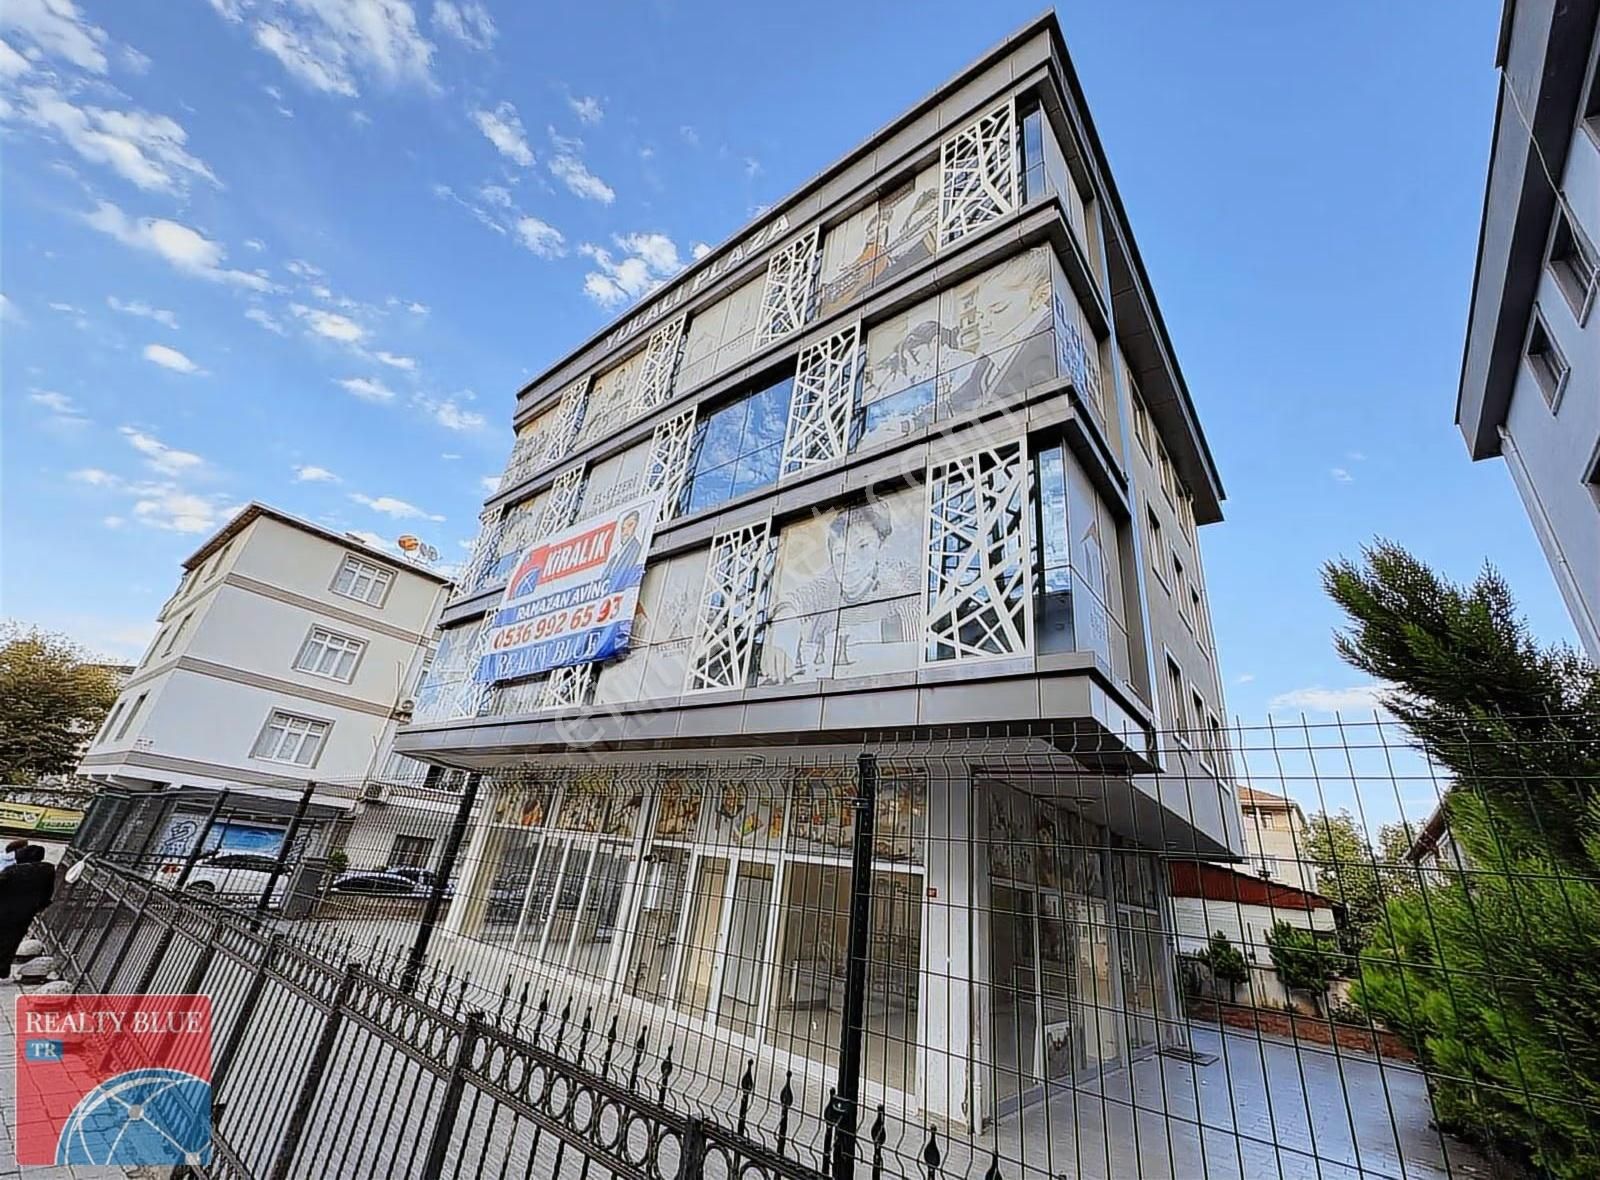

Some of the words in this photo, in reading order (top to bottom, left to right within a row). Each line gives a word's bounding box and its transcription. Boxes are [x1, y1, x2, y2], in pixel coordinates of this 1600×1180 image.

[691, 214, 791, 295] PLAZA
[544, 531, 609, 577] KİRALIK
[494, 624, 531, 650] 0536
[535, 615, 565, 637] 992
[570, 605, 595, 628] 65
[516, 591, 571, 620] RAMAZAN
[551, 631, 602, 663] BLUE
